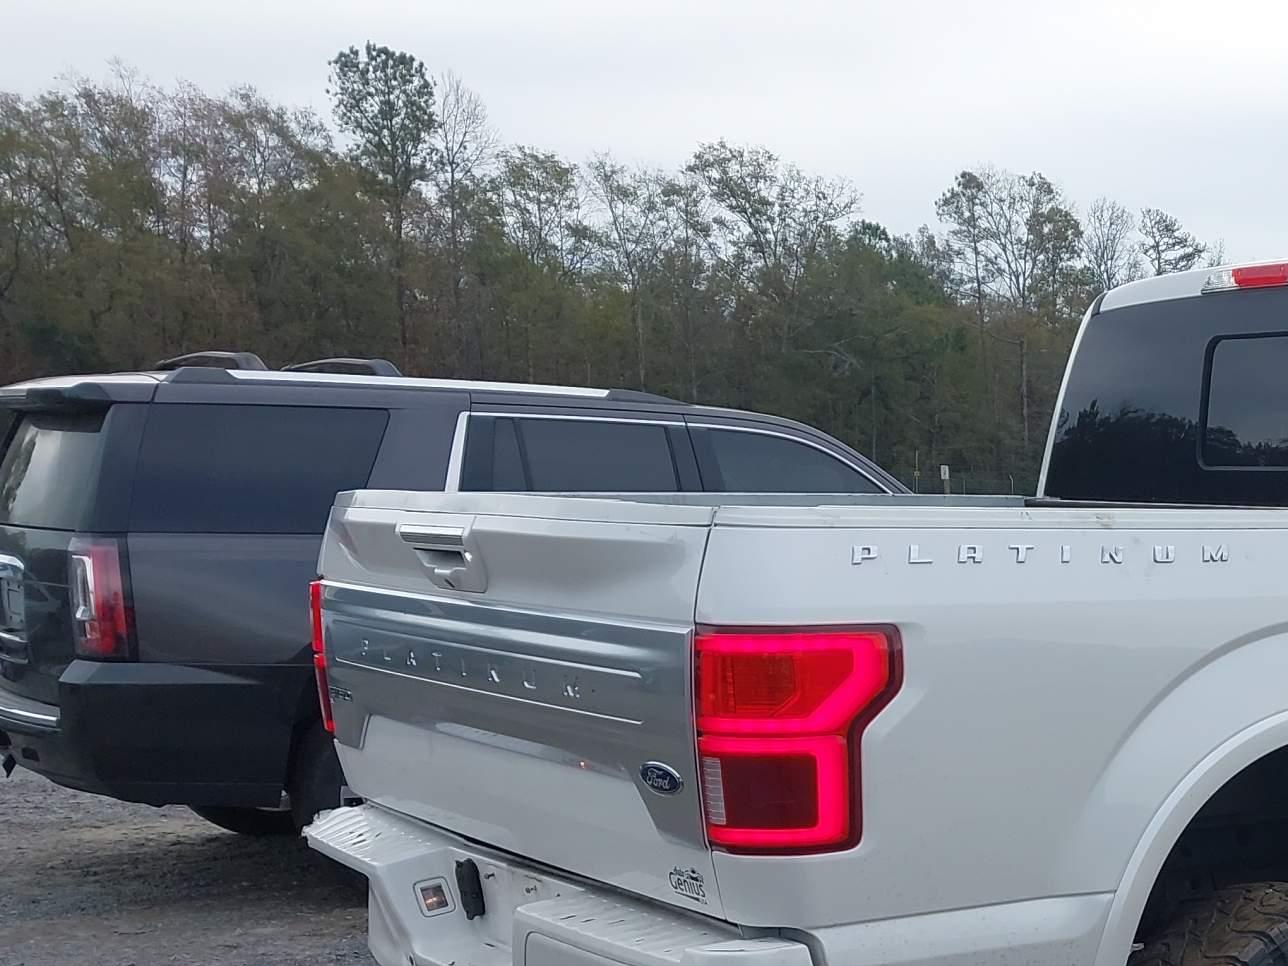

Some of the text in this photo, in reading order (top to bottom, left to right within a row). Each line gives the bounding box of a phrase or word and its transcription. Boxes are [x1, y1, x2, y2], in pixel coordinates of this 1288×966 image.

[851, 544, 1230, 565] PLATINUM
[362, 639, 581, 698] PLATINUM
[646, 767, 671, 790] Ford
[669, 871, 706, 898] Genius
